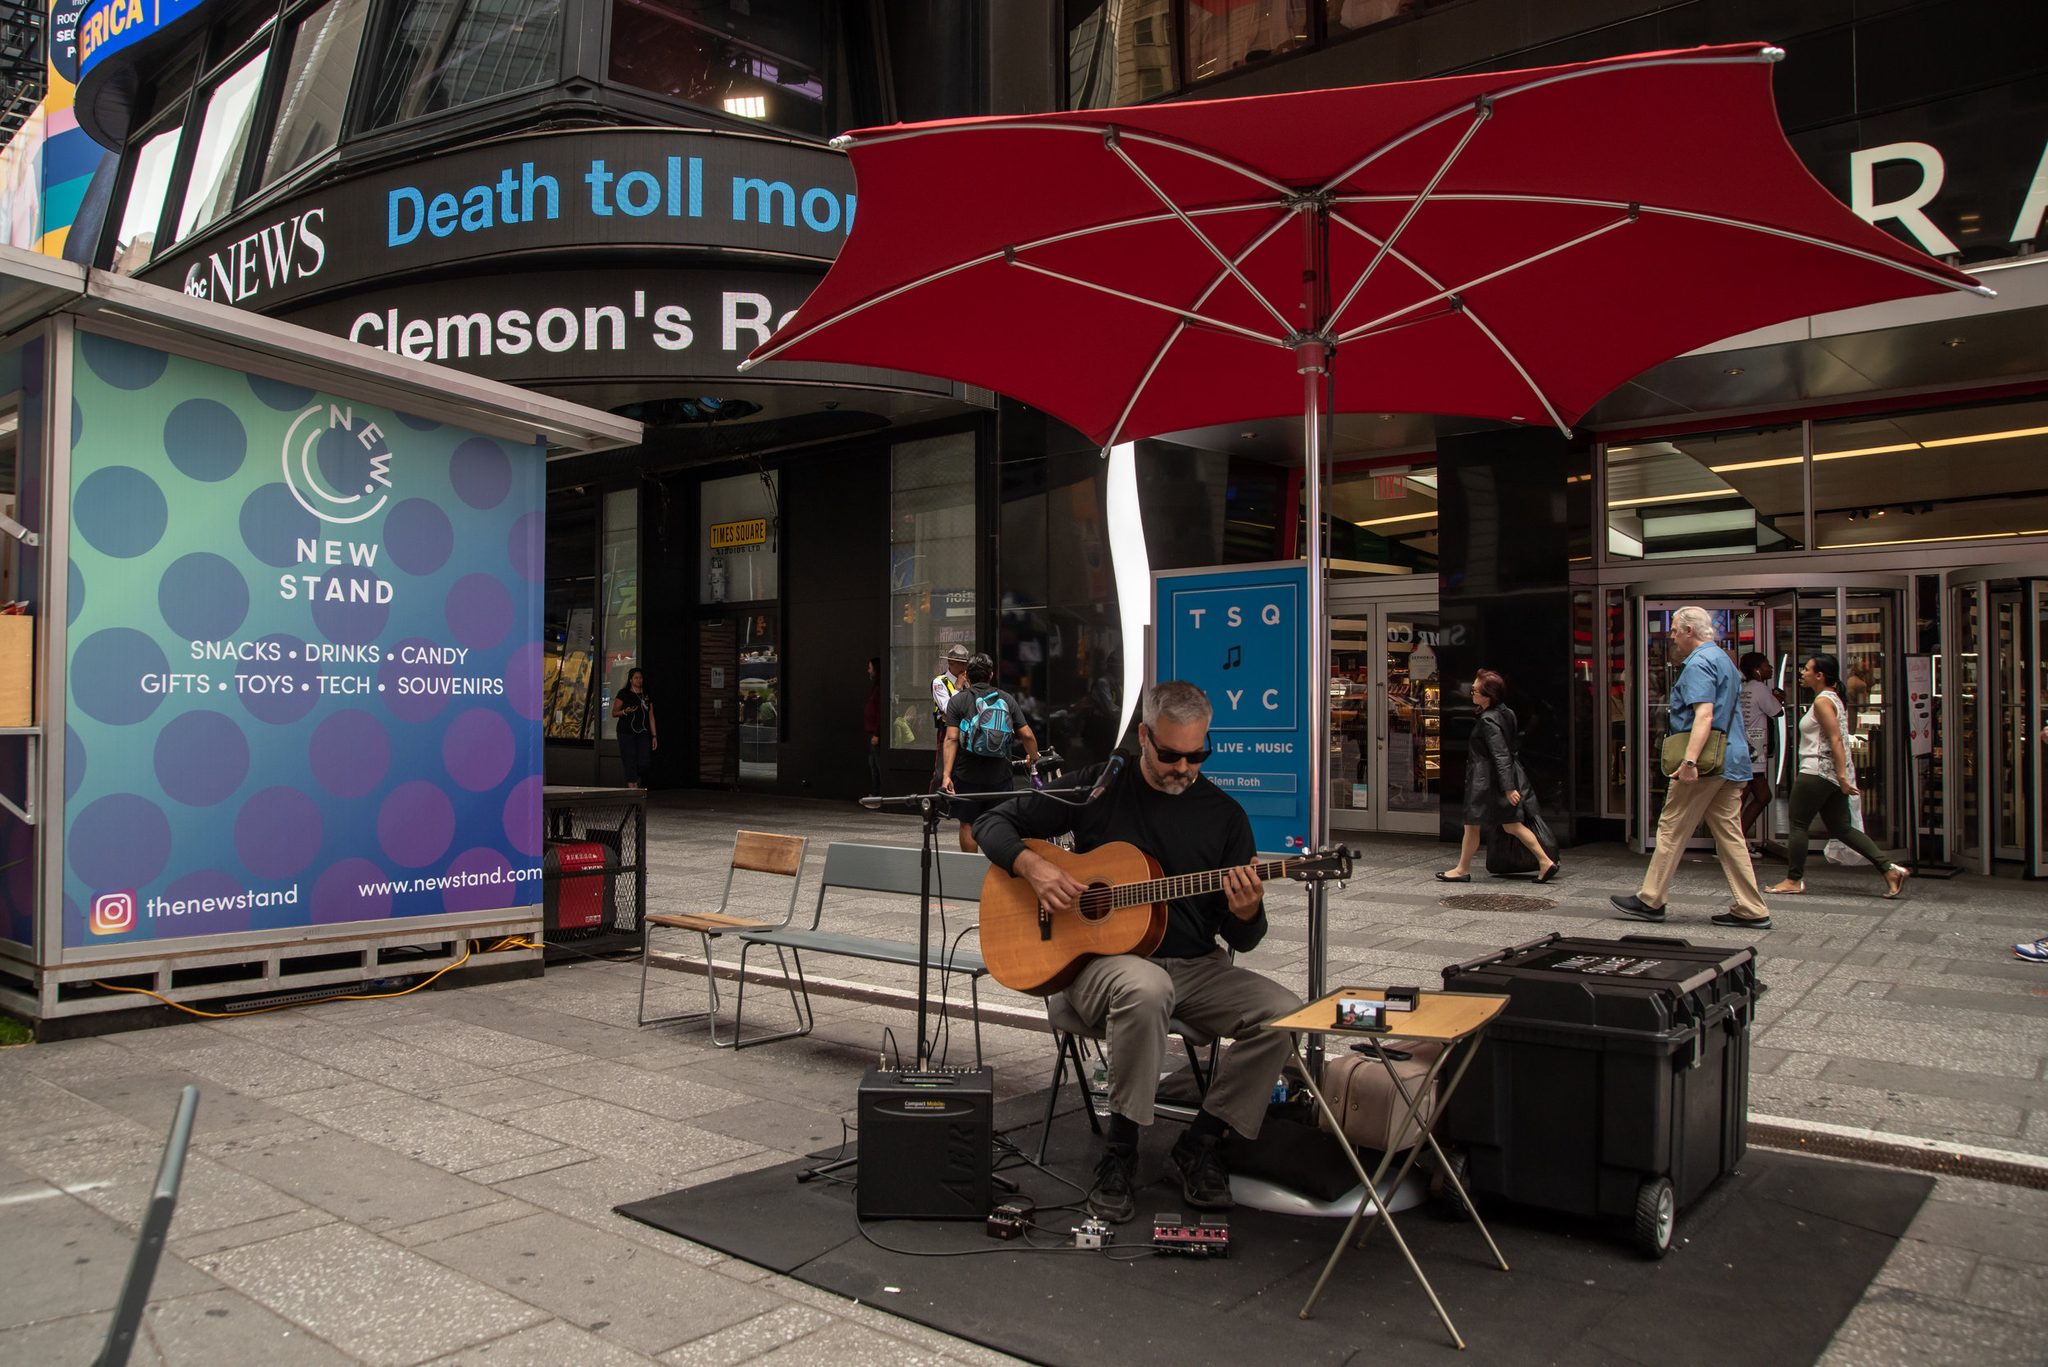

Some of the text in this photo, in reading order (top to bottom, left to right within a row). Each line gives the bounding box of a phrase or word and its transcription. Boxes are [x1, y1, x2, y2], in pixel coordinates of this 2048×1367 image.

[80, 0, 144, 65] ERICA
[387, 162, 560, 248] Death
[585, 156, 703, 217] toll
[208, 208, 325, 304] NEWS
[348, 290, 799, 362] Clemson's R
[712, 522, 764, 545] TIMES SQUARE
[296, 538, 379, 568] NEW
[279, 574, 394, 604] STAND
[191, 640, 469, 665] SNACKS DRINKS CANDY
[140, 673, 504, 695] GIFTS TOYS TECH SOUVENIRS
[1216, 742, 1293, 753] LIVE MUSIC
[1237, 777, 1261, 787] Roth
[358, 866, 543, 897] www.newstand.com
[146, 884, 298, 918] thenewstand
